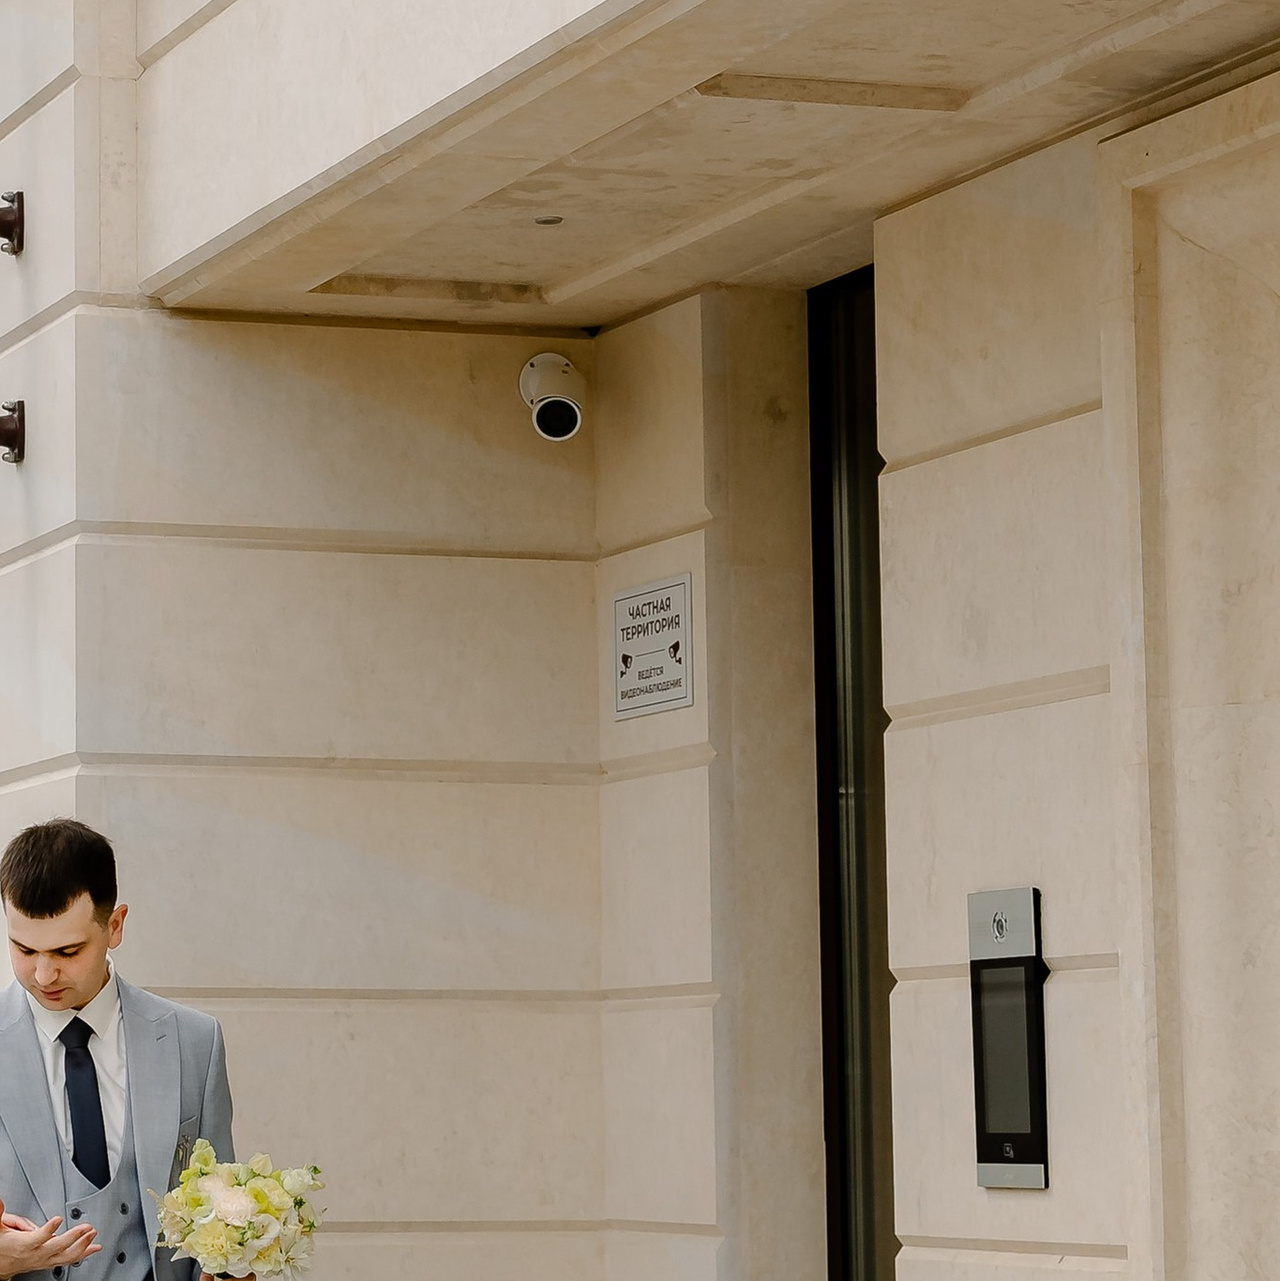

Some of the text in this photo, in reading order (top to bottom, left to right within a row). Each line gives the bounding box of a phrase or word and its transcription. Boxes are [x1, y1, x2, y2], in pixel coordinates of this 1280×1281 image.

[628, 597, 671, 620] ЧАСТНАЯ
[620, 614, 680, 642] ТЕРРИТОРИЯ
[621, 678, 682, 700] ВИДЕОНАБЛЮДЕНИЕ
